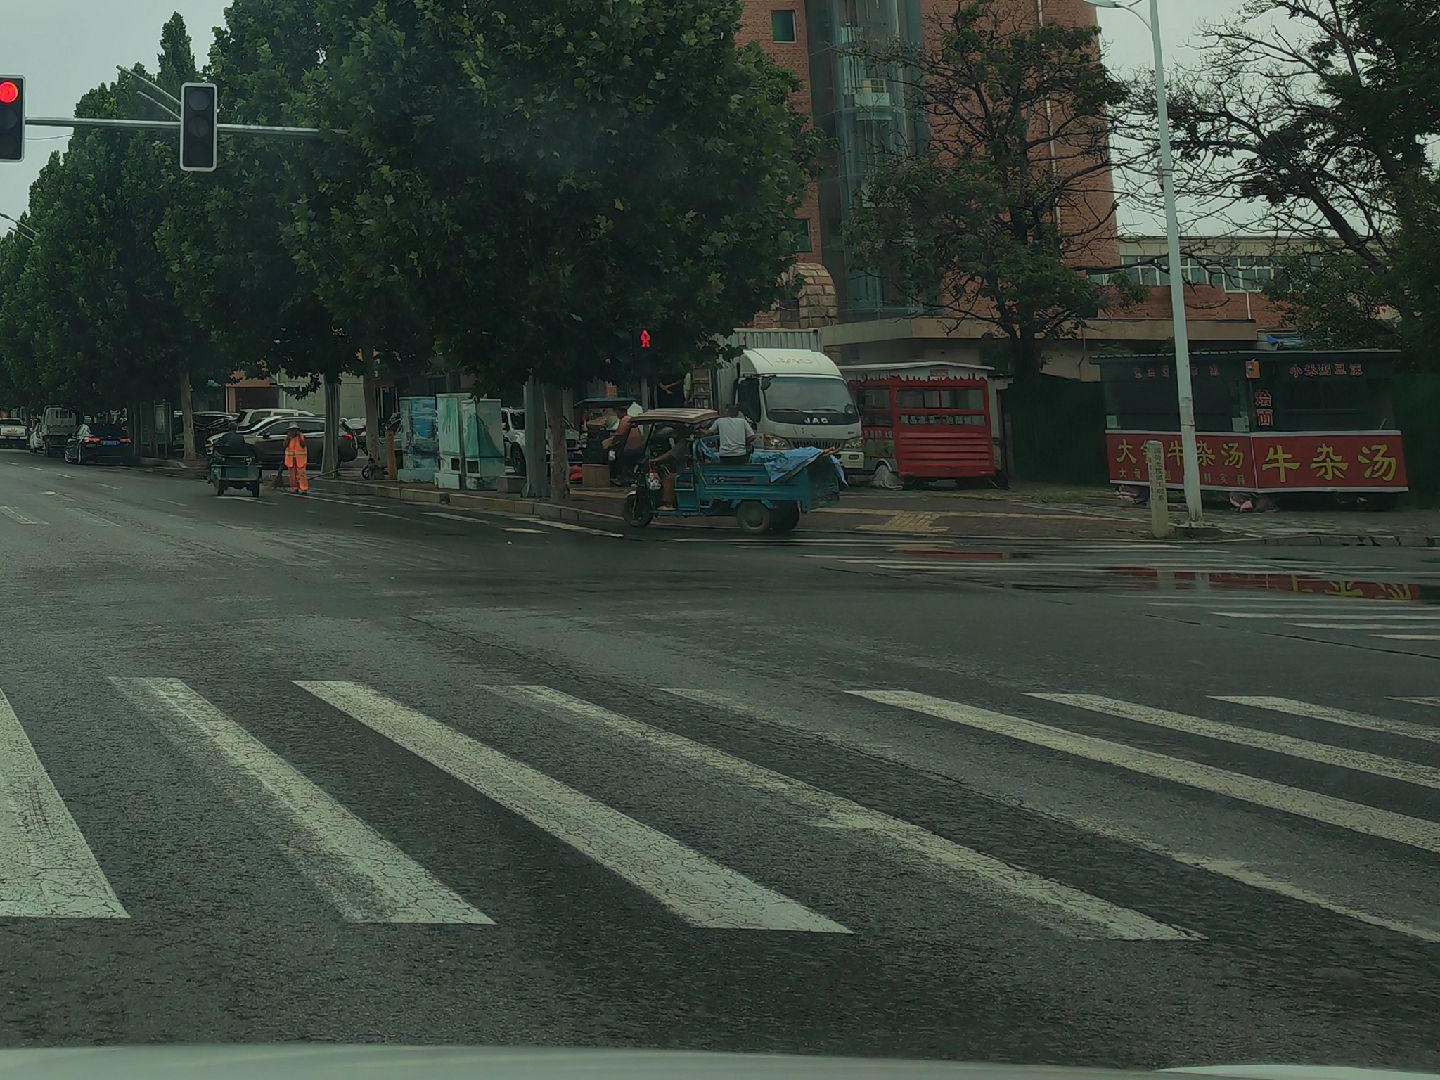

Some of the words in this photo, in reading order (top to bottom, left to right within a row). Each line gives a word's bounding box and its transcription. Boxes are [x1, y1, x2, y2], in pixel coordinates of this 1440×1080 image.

[1116, 438, 1245, 469] 大牛杂汤
[1261, 443, 1398, 483] 牛杂汤
